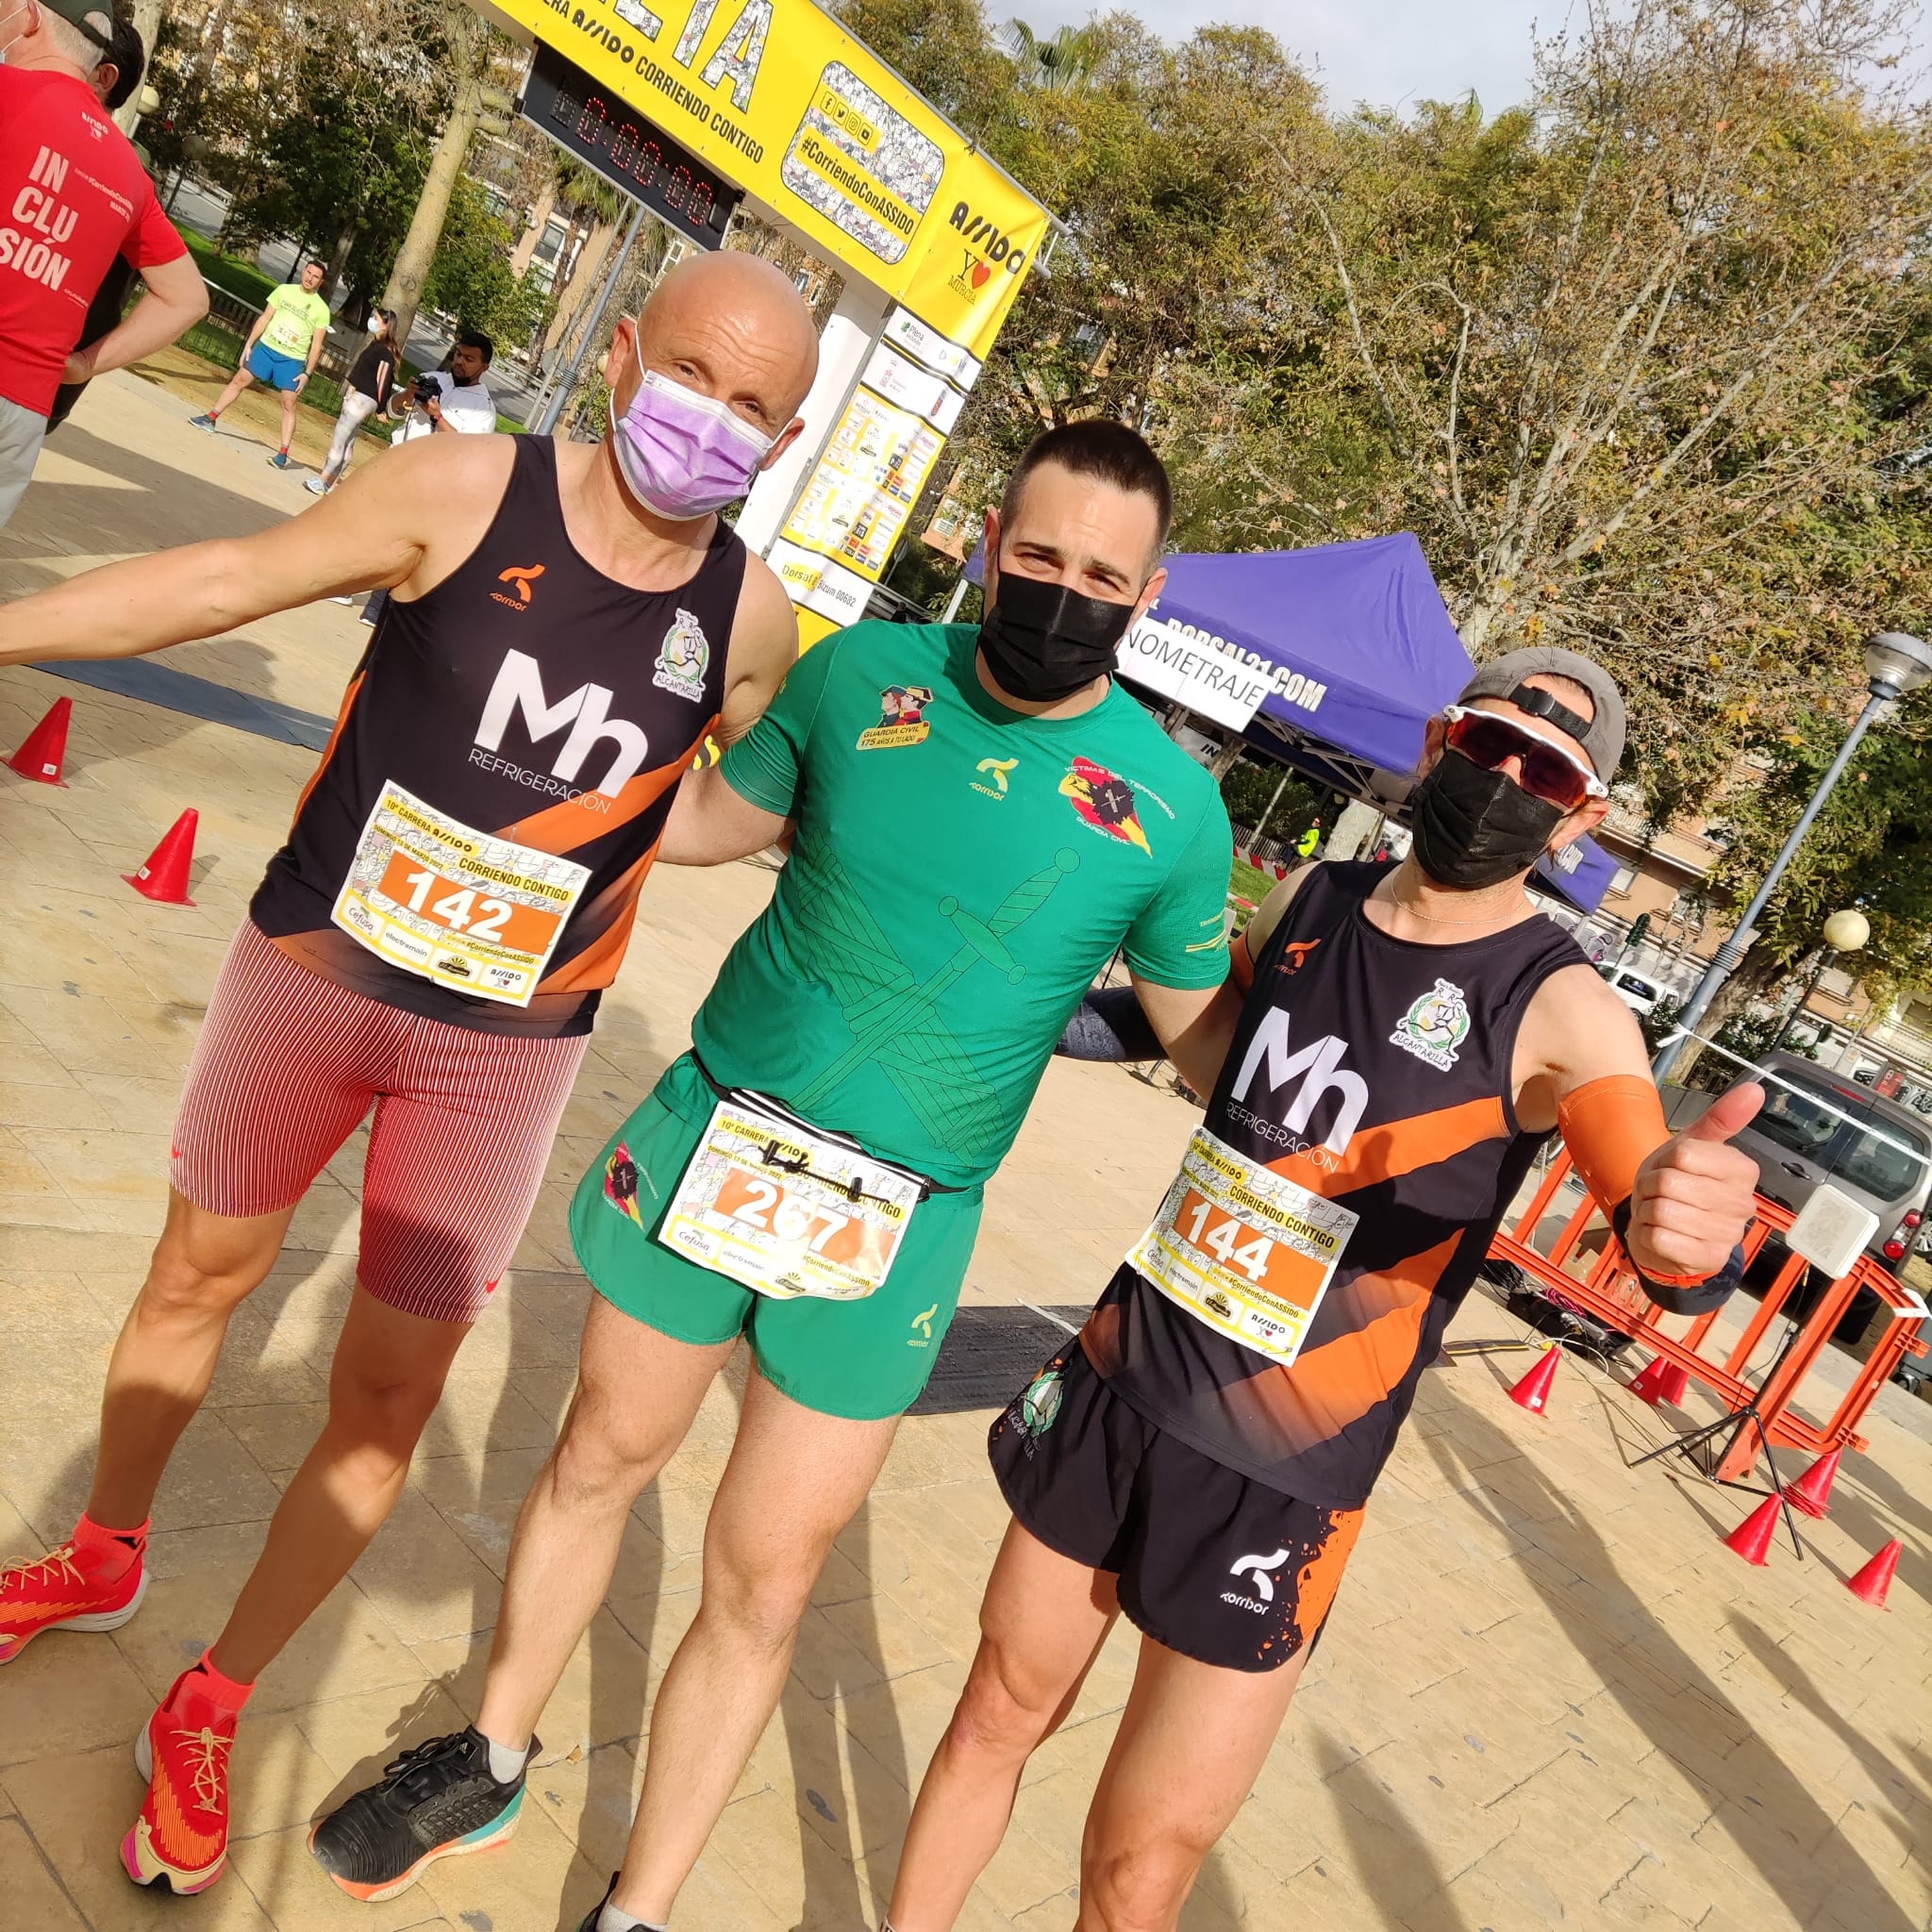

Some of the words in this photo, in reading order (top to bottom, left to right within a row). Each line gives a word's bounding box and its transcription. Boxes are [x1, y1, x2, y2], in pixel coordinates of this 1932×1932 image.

[572, 8, 635, 63] ASSIDO
[635, 55, 710, 123] CORRIENDO
[709, 112, 765, 164] CONTIGO
[28, 144, 70, 193] IN
[800, 136, 915, 236] #CorriendoConASSIDO
[11, 186, 79, 243] CLU
[0, 226, 73, 292] SIÓN
[948, 201, 1026, 275] ASSIDO
[947, 275, 976, 306] MURCIA
[781, 564, 814, 584] Dorsal
[817, 579, 837, 597] Bizum
[835, 589, 857, 608] 00682
[655, 673, 702, 702] ALCANTARILLA
[474, 647, 649, 799] Mh
[860, 738, 875, 747] 175
[863, 727, 898, 739] GUARDIA
[899, 725, 920, 734] CIVIL
[468, 747, 612, 815] REFRIGERACIÓN
[1128, 779, 1176, 820] TERRORISMO
[397, 807, 432, 833] CARRERA
[432, 827, 473, 852] ASSIDO
[1075, 815, 1109, 839] GUARDIA
[1110, 835, 1131, 846] CIVIL
[458, 857, 522, 888] CORRIENDO
[523, 877, 570, 902] CONTIGO
[405, 869, 513, 943] 142
[490, 968, 522, 981] ASSIDO
[1392, 1032, 1451, 1069] ALCANTARILLA
[1230, 1005, 1370, 1158] Mh
[1225, 1101, 1341, 1174] REFRIGERACIÓN
[1214, 1158, 1242, 1180] ASSIDO
[730, 1178, 849, 1256] 267
[1228, 1185, 1286, 1224] CORRIENDO
[1284, 1216, 1336, 1249] CONTIGO
[1188, 1202, 1274, 1282] 144
[1227, 1276, 1300, 1320] #CorriendoConASSIDO
[1250, 1313, 1286, 1335] ASSIDO
